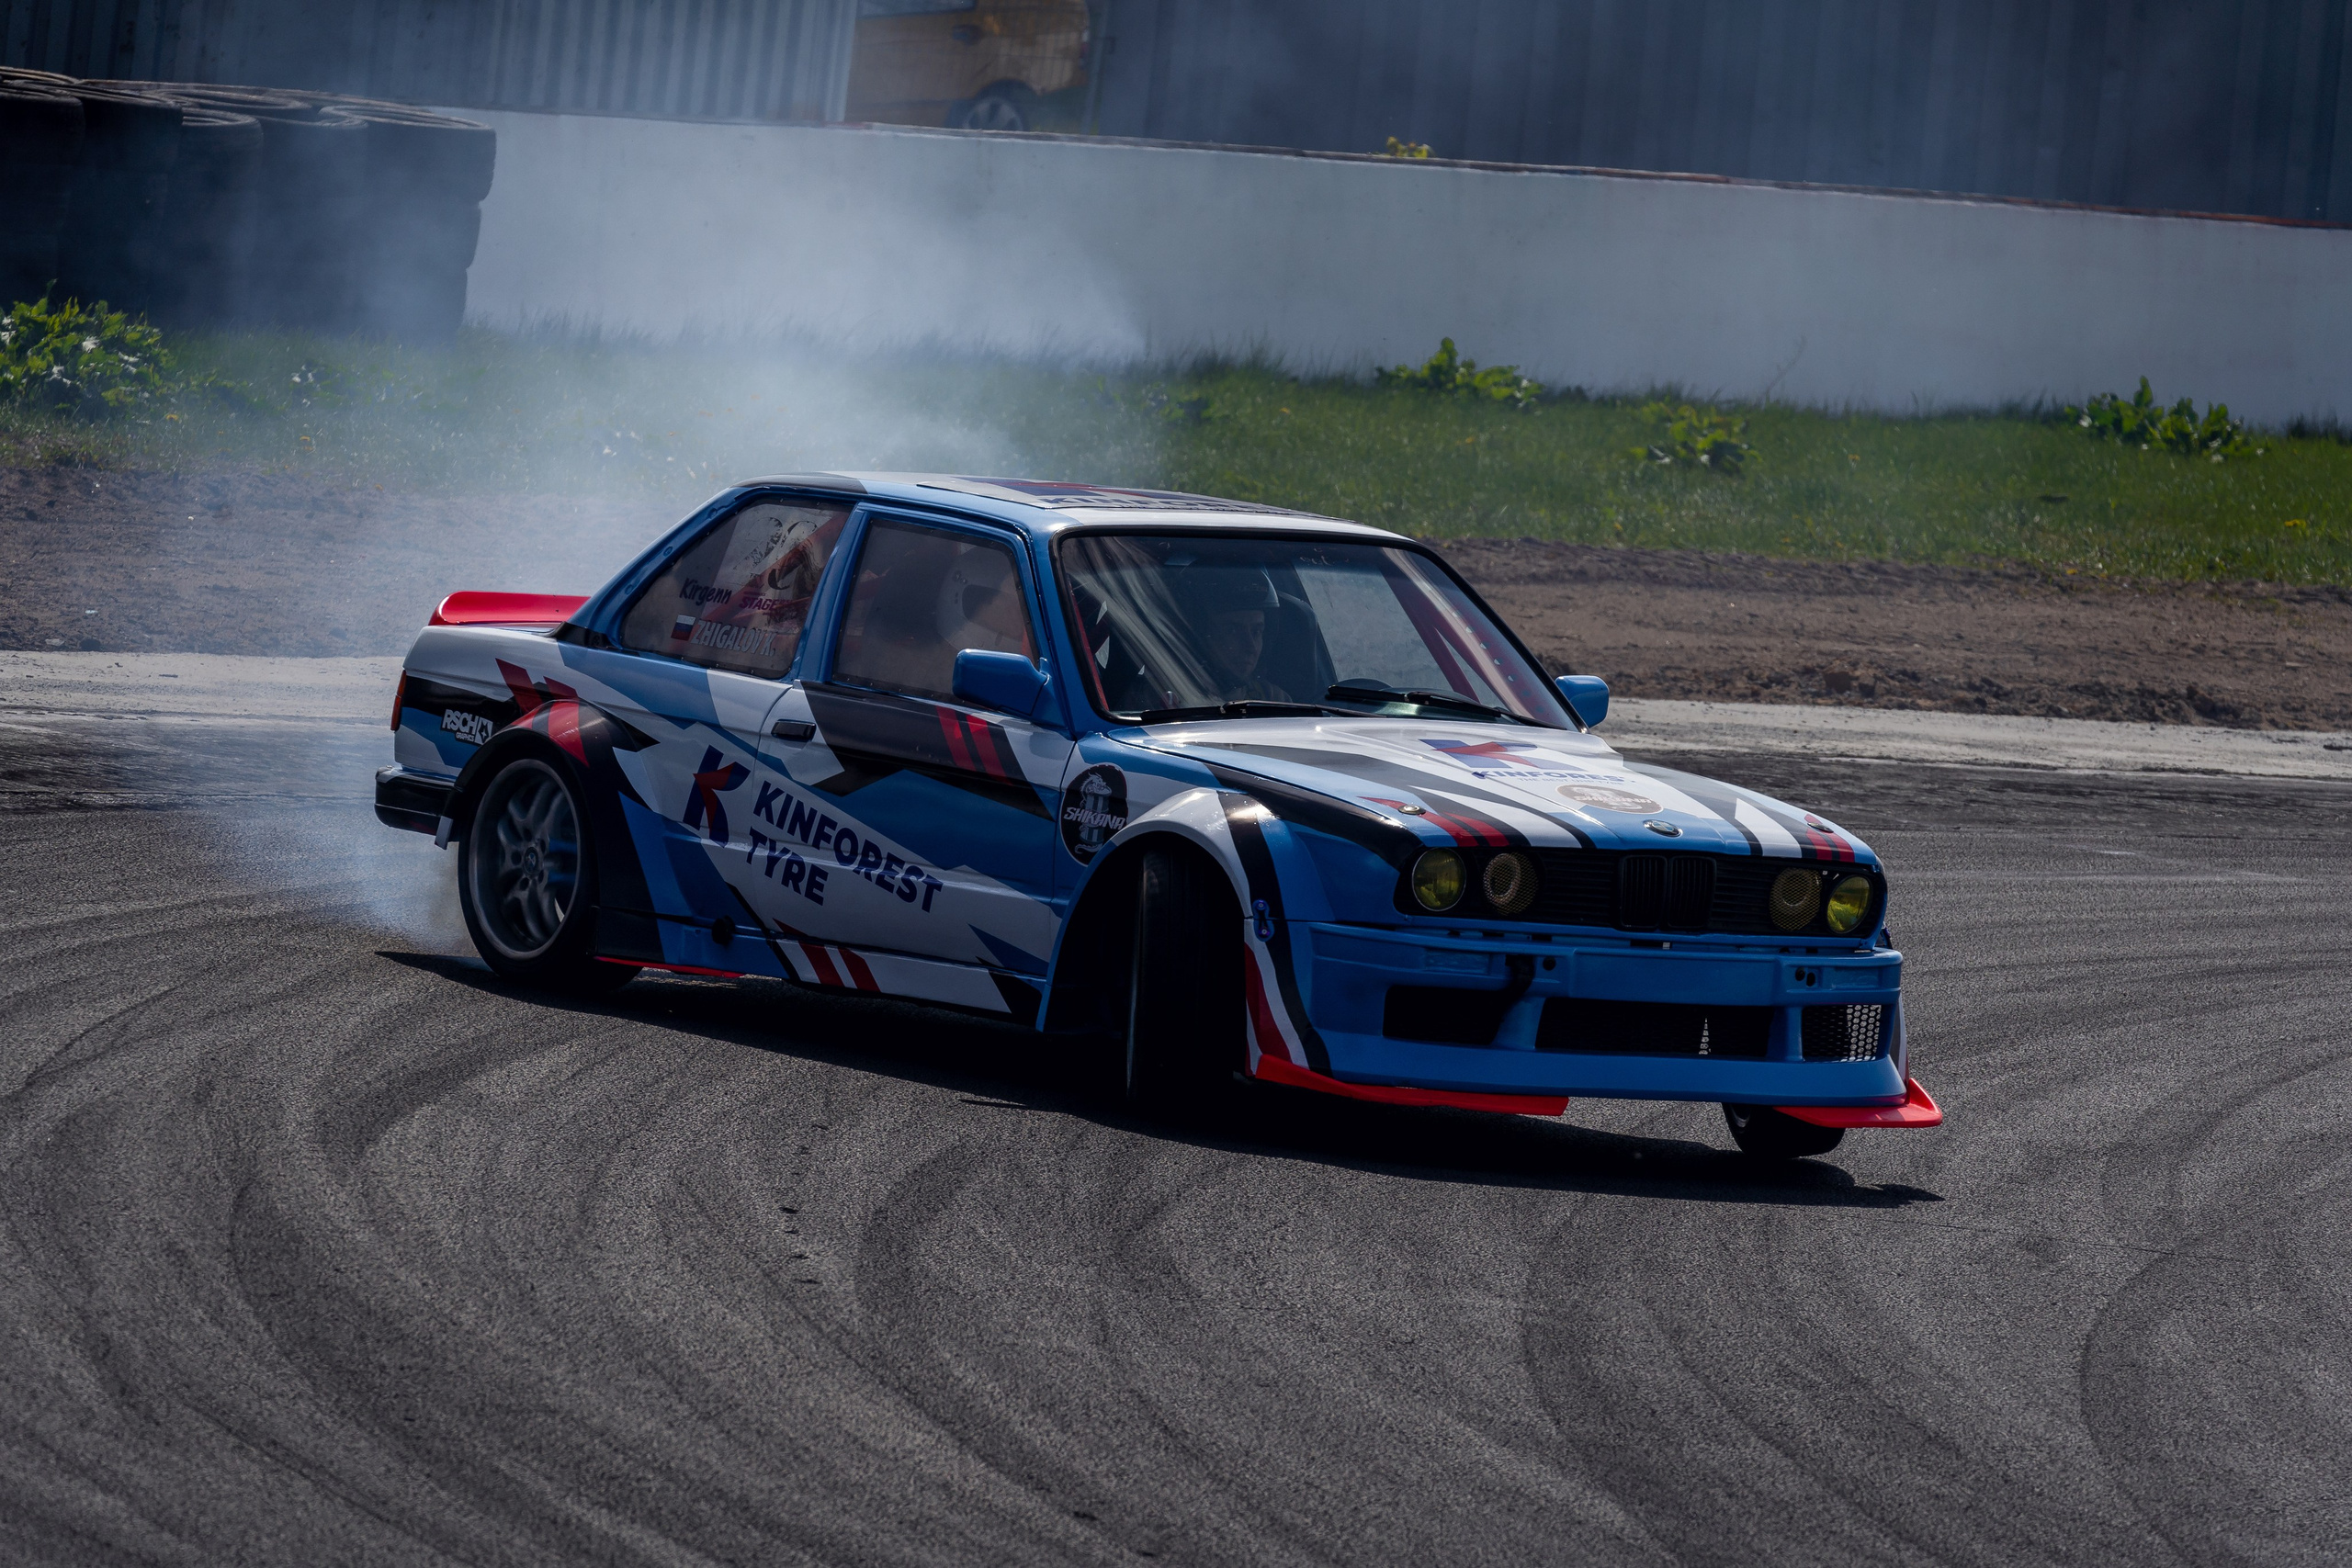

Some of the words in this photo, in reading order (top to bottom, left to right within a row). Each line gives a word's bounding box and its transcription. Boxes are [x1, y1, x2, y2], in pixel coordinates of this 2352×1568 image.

[679, 578, 732, 606] Kirgenn
[691, 619, 767, 655] ZHIGALOV
[442, 708, 479, 735] RSCH
[1472, 771, 1637, 784] KINFORES
[1063, 807, 1126, 830] SHIKANA
[752, 781, 944, 914] KINFOREST
[745, 826, 830, 907] TYRE
